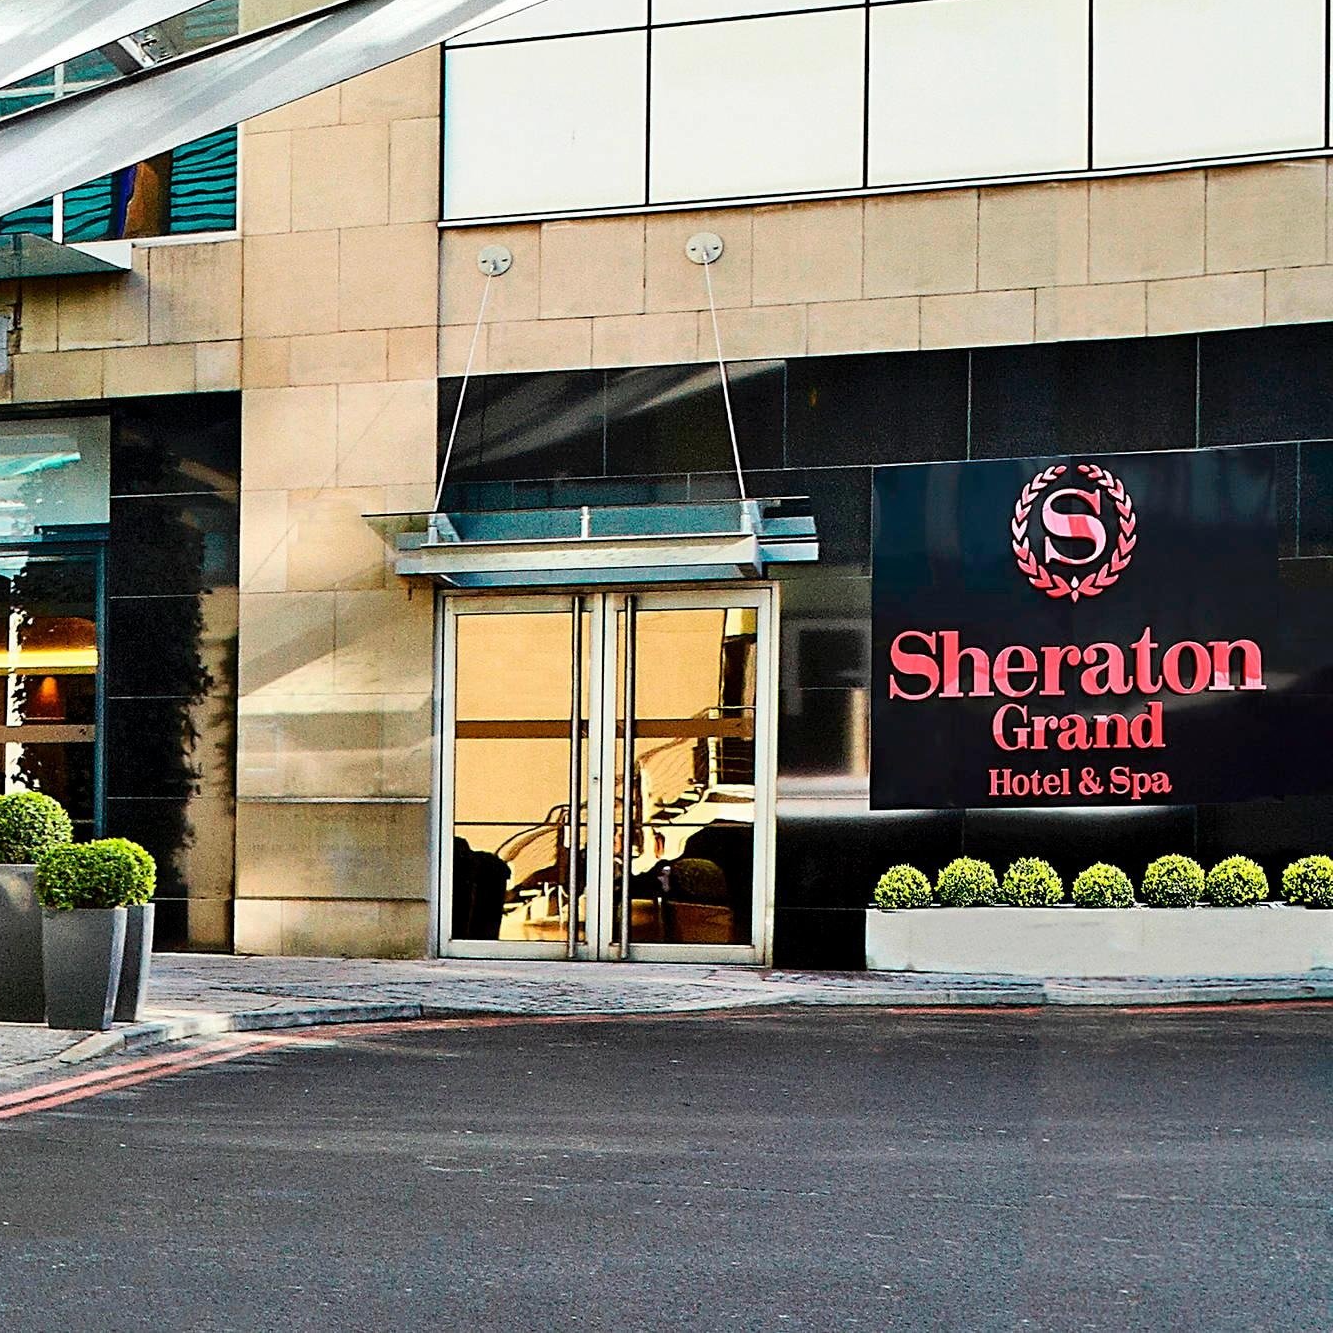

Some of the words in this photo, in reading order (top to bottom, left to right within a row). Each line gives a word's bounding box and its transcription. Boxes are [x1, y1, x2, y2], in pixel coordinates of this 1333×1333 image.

[1042, 487, 1107, 565] S
[889, 626, 1267, 701] Sheraton
[992, 701, 1167, 751] Grand
[988, 768, 1072, 797] Hotel
[1078, 766, 1105, 796] &
[1109, 766, 1173, 800] Spa
